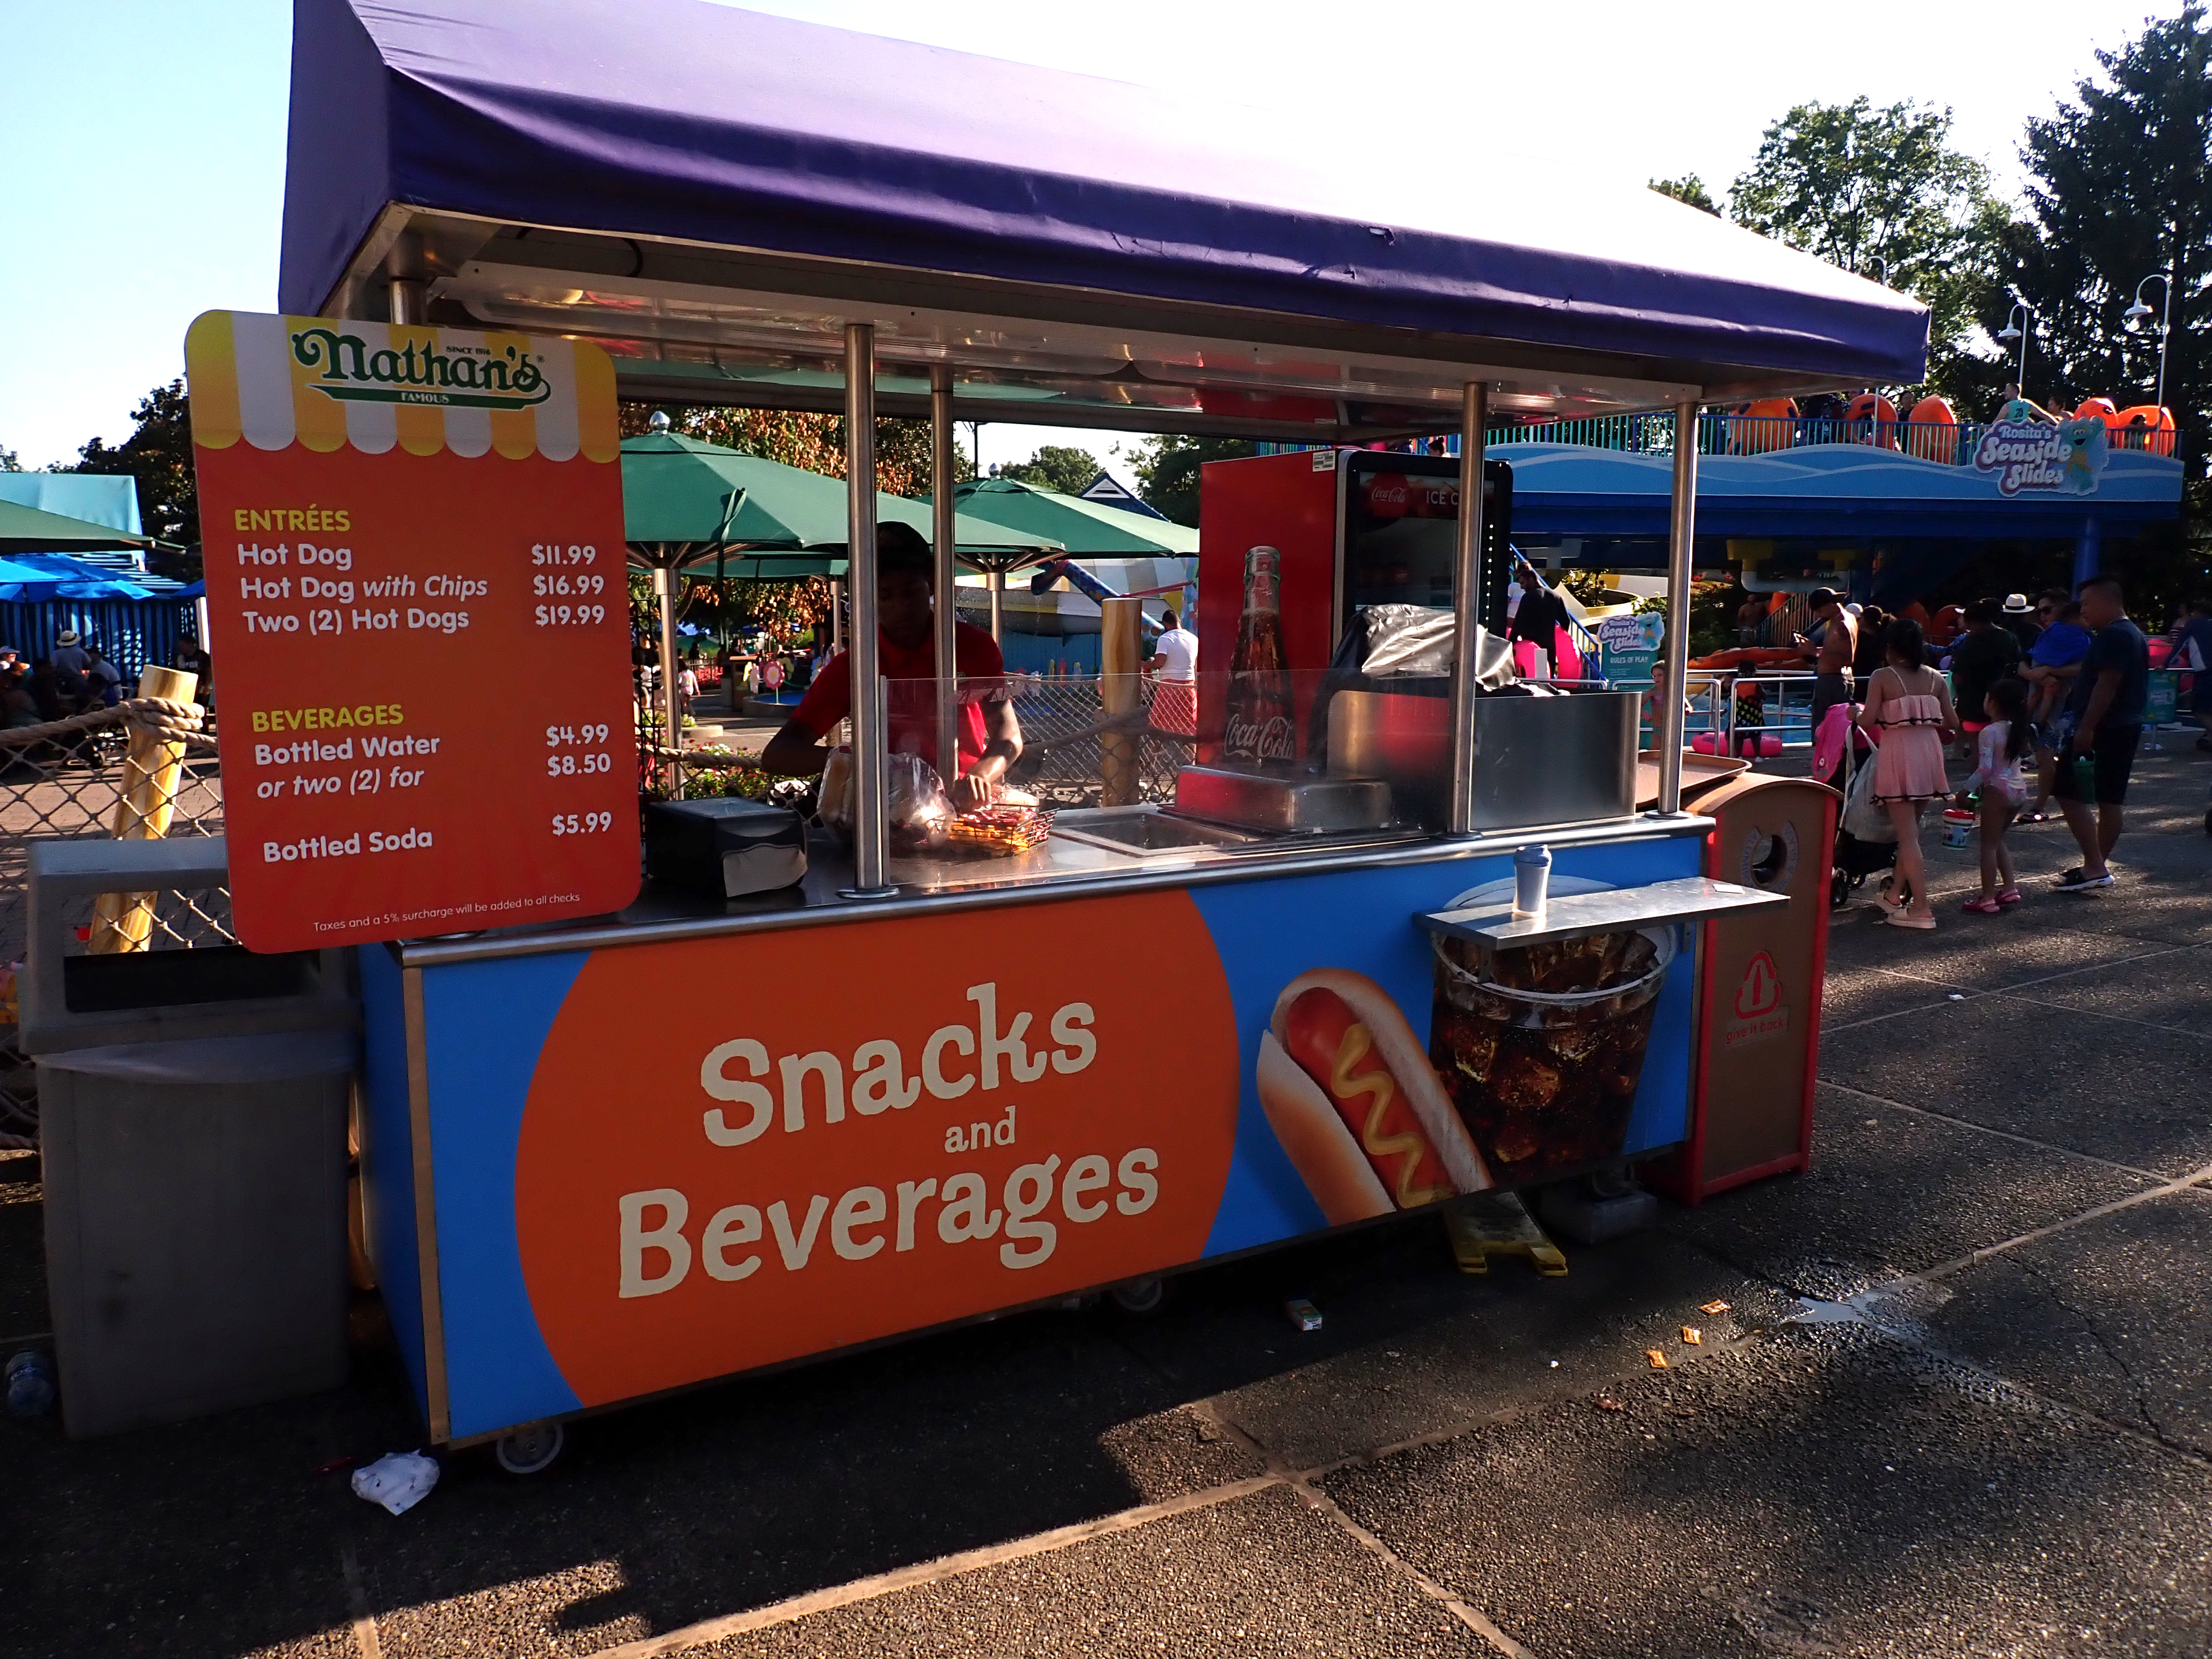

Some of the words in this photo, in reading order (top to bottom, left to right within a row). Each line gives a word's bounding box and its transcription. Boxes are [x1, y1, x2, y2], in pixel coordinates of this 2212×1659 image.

[291, 328, 542, 393] Nathan's
[446, 345, 472, 355] SINCE
[401, 392, 449, 404] FAMOUS
[1999, 425, 2052, 439] Rosita's
[1981, 435, 2073, 466] Seaside
[2006, 460, 2064, 490] Slides
[1426, 491, 1447, 505] ICE
[234, 503, 351, 531] ENTRÉES
[237, 543, 289, 565] Hot
[298, 543, 352, 571] Dog
[531, 543, 596, 566] $11.99
[241, 577, 291, 599] Hot
[300, 576, 354, 604] Dog
[363, 575, 416, 597] with
[424, 574, 488, 602] Chips
[533, 574, 604, 597] $16.99
[242, 611, 299, 633] Two
[309, 609, 342, 636] (2)
[352, 608, 399, 630] Hot
[407, 608, 469, 634] Dogs
[535, 604, 605, 627] $19.99
[252, 704, 404, 732] BEVERAGES
[255, 737, 353, 765] Bottled
[362, 735, 440, 758] Water
[546, 724, 609, 748] $4.99
[547, 753, 611, 778] $8.50
[257, 781, 285, 799] or
[293, 775, 341, 795] two
[350, 768, 380, 796] (2)
[389, 766, 425, 788] for
[552, 811, 612, 837] $5.99
[263, 832, 361, 863] Bottled
[369, 827, 432, 852] Soda
[313, 921, 346, 932] Taxes
[349, 916, 370, 927] and
[384, 913, 399, 924] 5%
[402, 908, 453, 921] surcharge
[456, 904, 472, 914] will
[475, 902, 488, 912] be
[490, 898, 521, 910] added
[524, 898, 533, 906] to
[536, 895, 547, 905] all
[549, 893, 580, 904] checks
[1726, 1027, 1747, 1044] give
[1750, 1022, 1759, 1035] it
[1760, 1016, 1783, 1032] back
[700, 982, 1097, 1147] Snacks
[945, 1105, 1016, 1153] and
[618, 1147, 1159, 1298] Beverages
